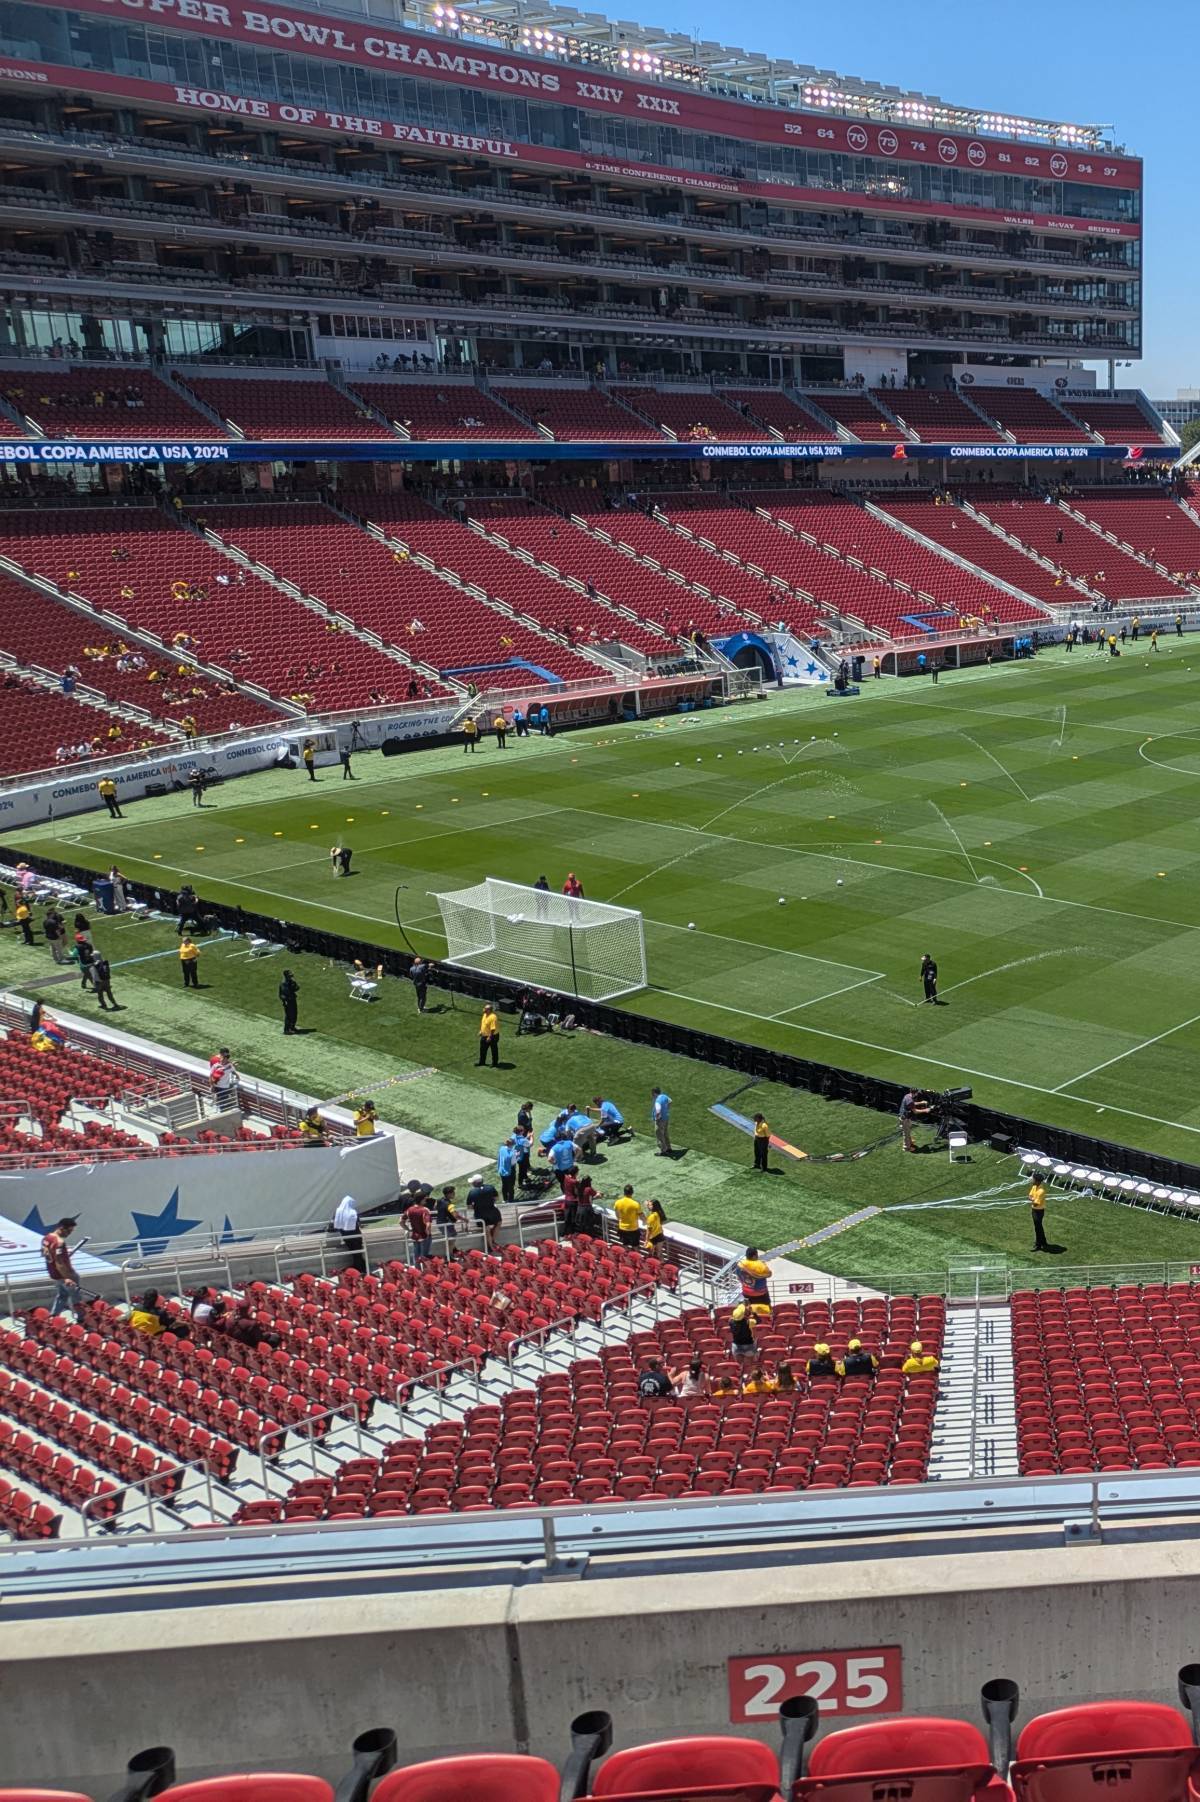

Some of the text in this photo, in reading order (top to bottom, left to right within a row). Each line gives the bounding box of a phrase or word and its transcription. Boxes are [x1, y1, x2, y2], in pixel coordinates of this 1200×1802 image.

[242, 11, 355, 52] BOWL
[363, 37, 560, 92] CHAMPIONS
[576, 81, 623, 105] XXIV
[636, 94, 680, 116] XXIX
[174, 87, 518, 157] HOME OF THE FAITHFUL
[784, 124, 1118, 177] 52 64 70 73 74 79 80 81 82 87 94 97
[622, 168, 684, 184] CONFERENCE
[685, 177, 739, 192] CHAMPIONS
[41, 446, 87, 460] COPA
[88, 446, 160, 460] AMERICA
[162, 446, 192, 460] USA
[193, 446, 229, 460] 2024
[703, 446, 842, 456] CONMEBOL COPA AMERICA USA 2024
[950, 447, 1089, 457] CONMEBOL COPA AMERICA USA 2024
[387, 719, 421, 731] ROCKING
[422, 717, 438, 726] THE
[226, 745, 265, 760] CONMEBOL
[126, 769, 162, 783] AMERICA
[178, 760, 197, 772] 2024
[790, 1283, 813, 1293] 124
[744, 1656, 888, 1716] 225
